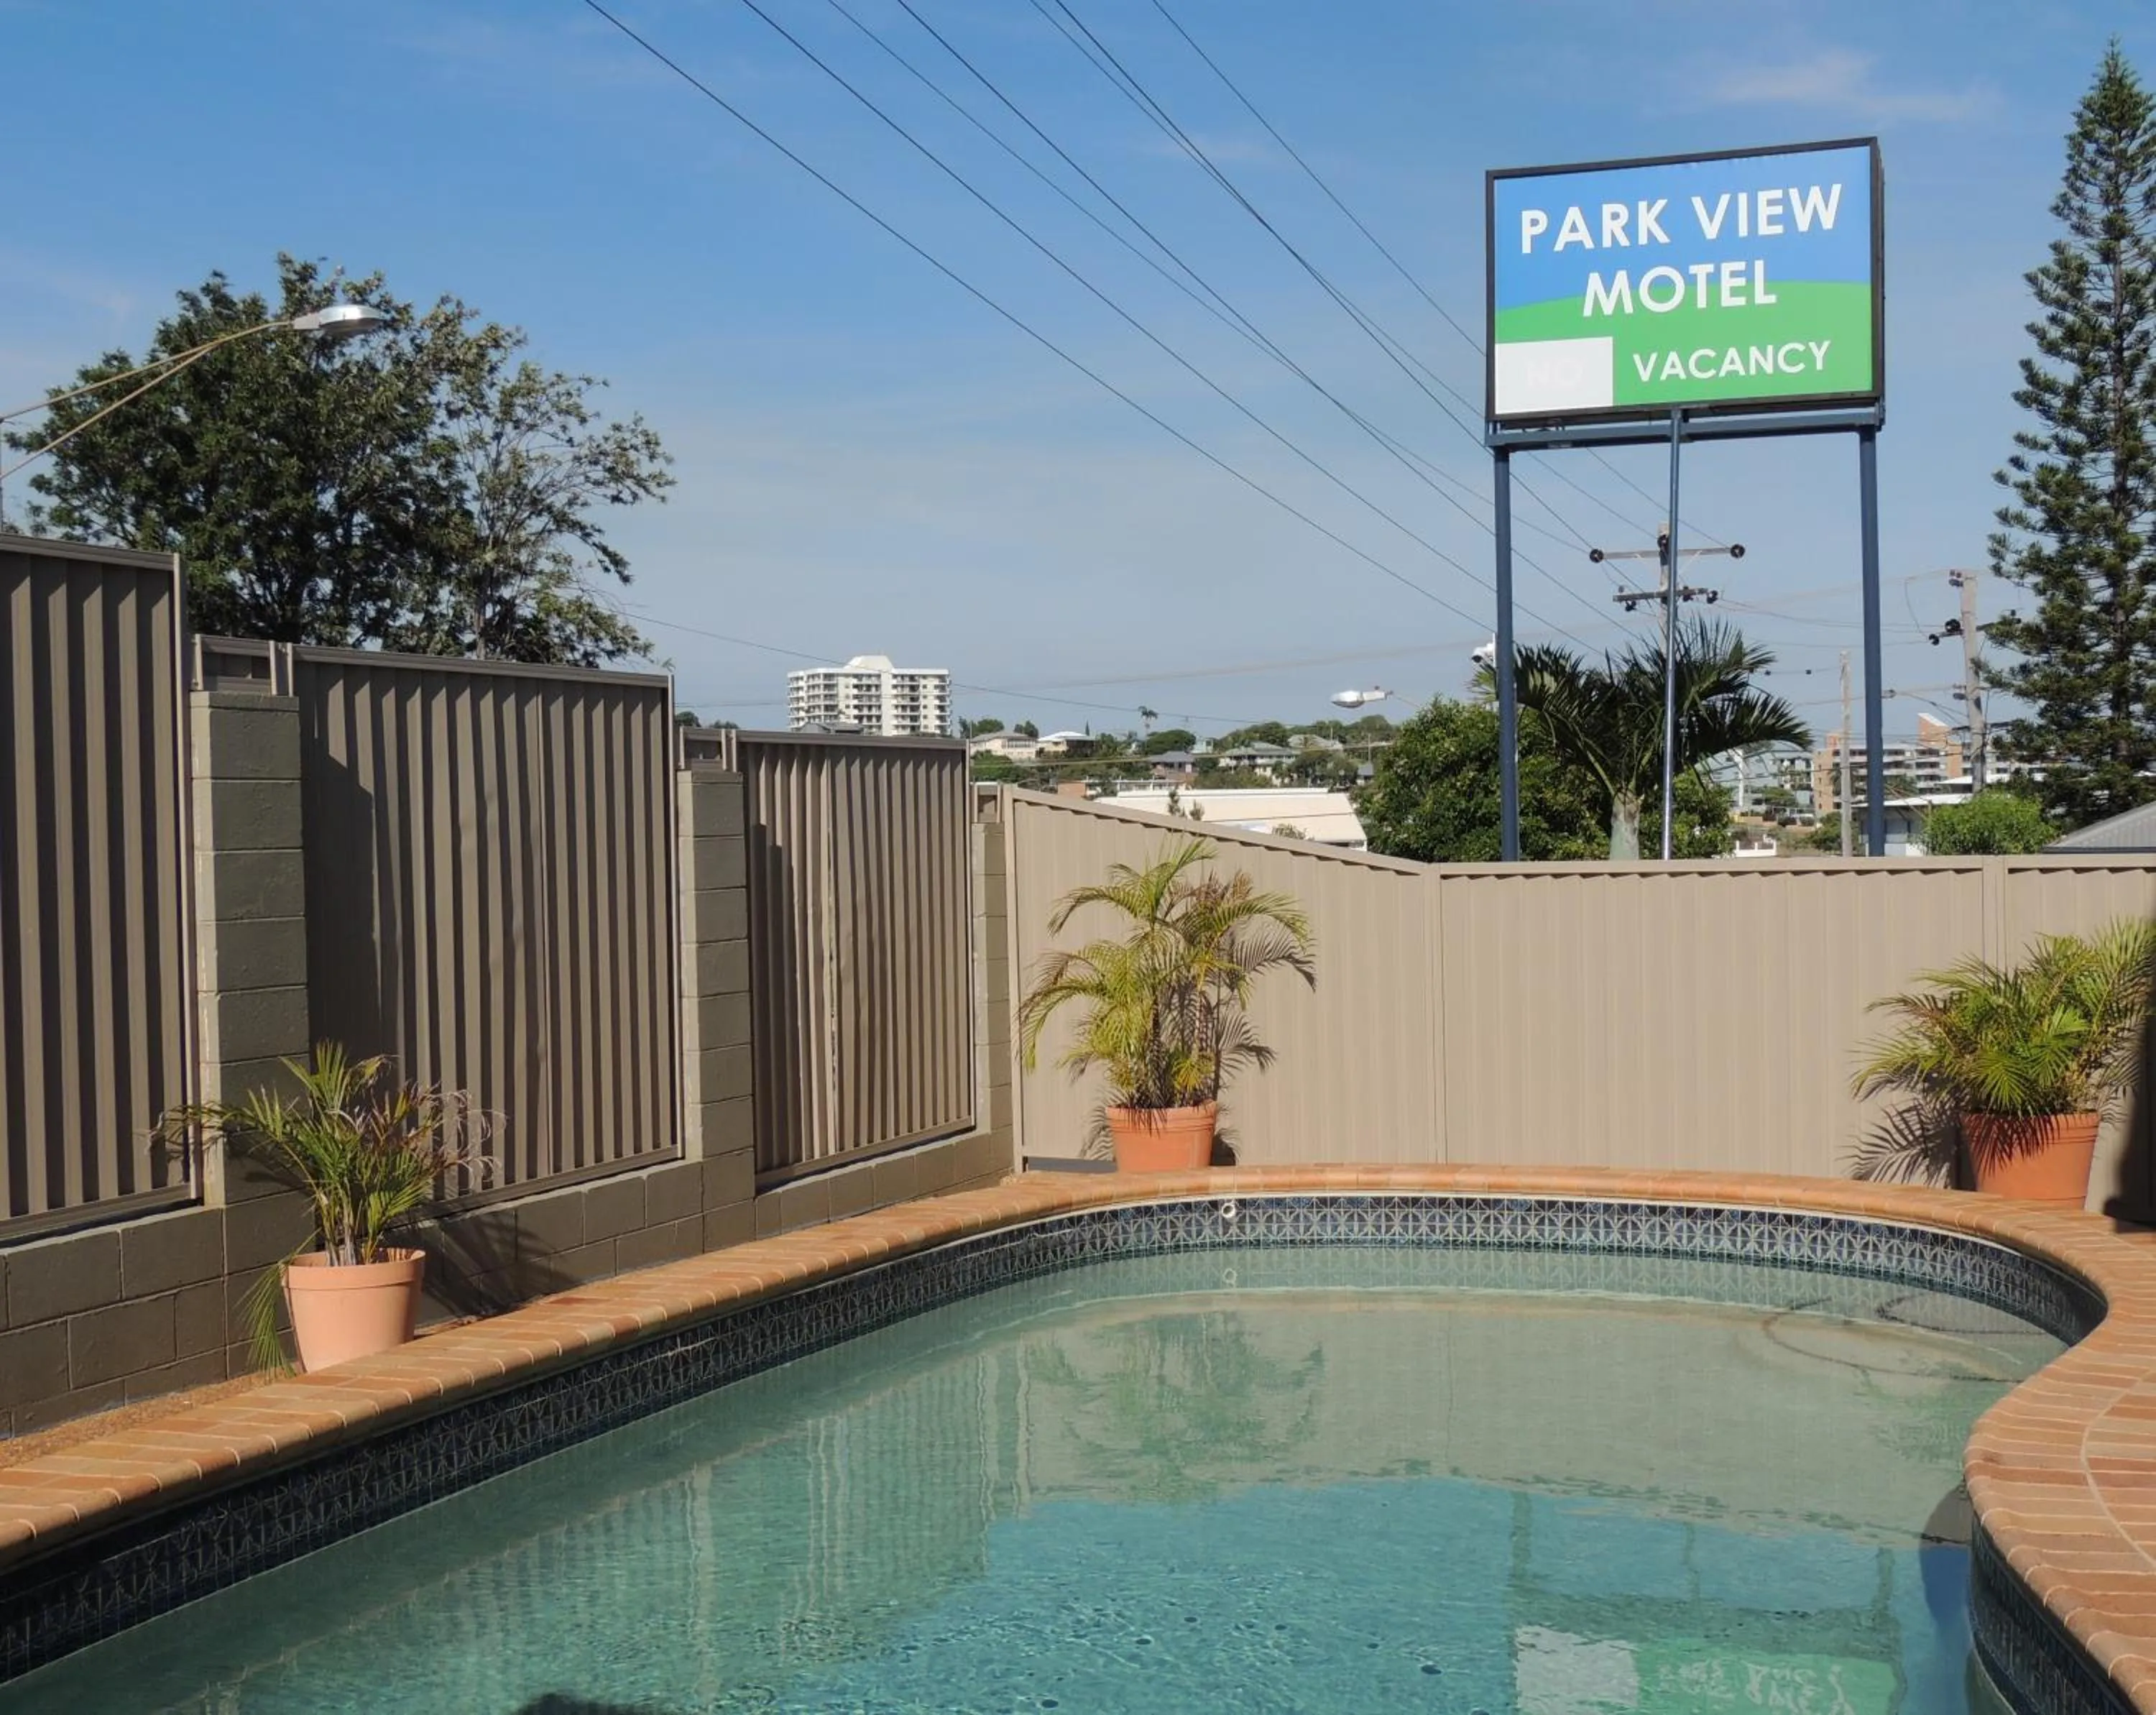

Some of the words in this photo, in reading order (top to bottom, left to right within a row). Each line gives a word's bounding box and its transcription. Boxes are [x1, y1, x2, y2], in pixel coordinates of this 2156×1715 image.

[1521, 198, 1670, 254] PARK
[1692, 183, 1842, 240] VIEW
[1583, 259, 1777, 317] MOTEL
[1633, 341, 1830, 382] VACANCY
